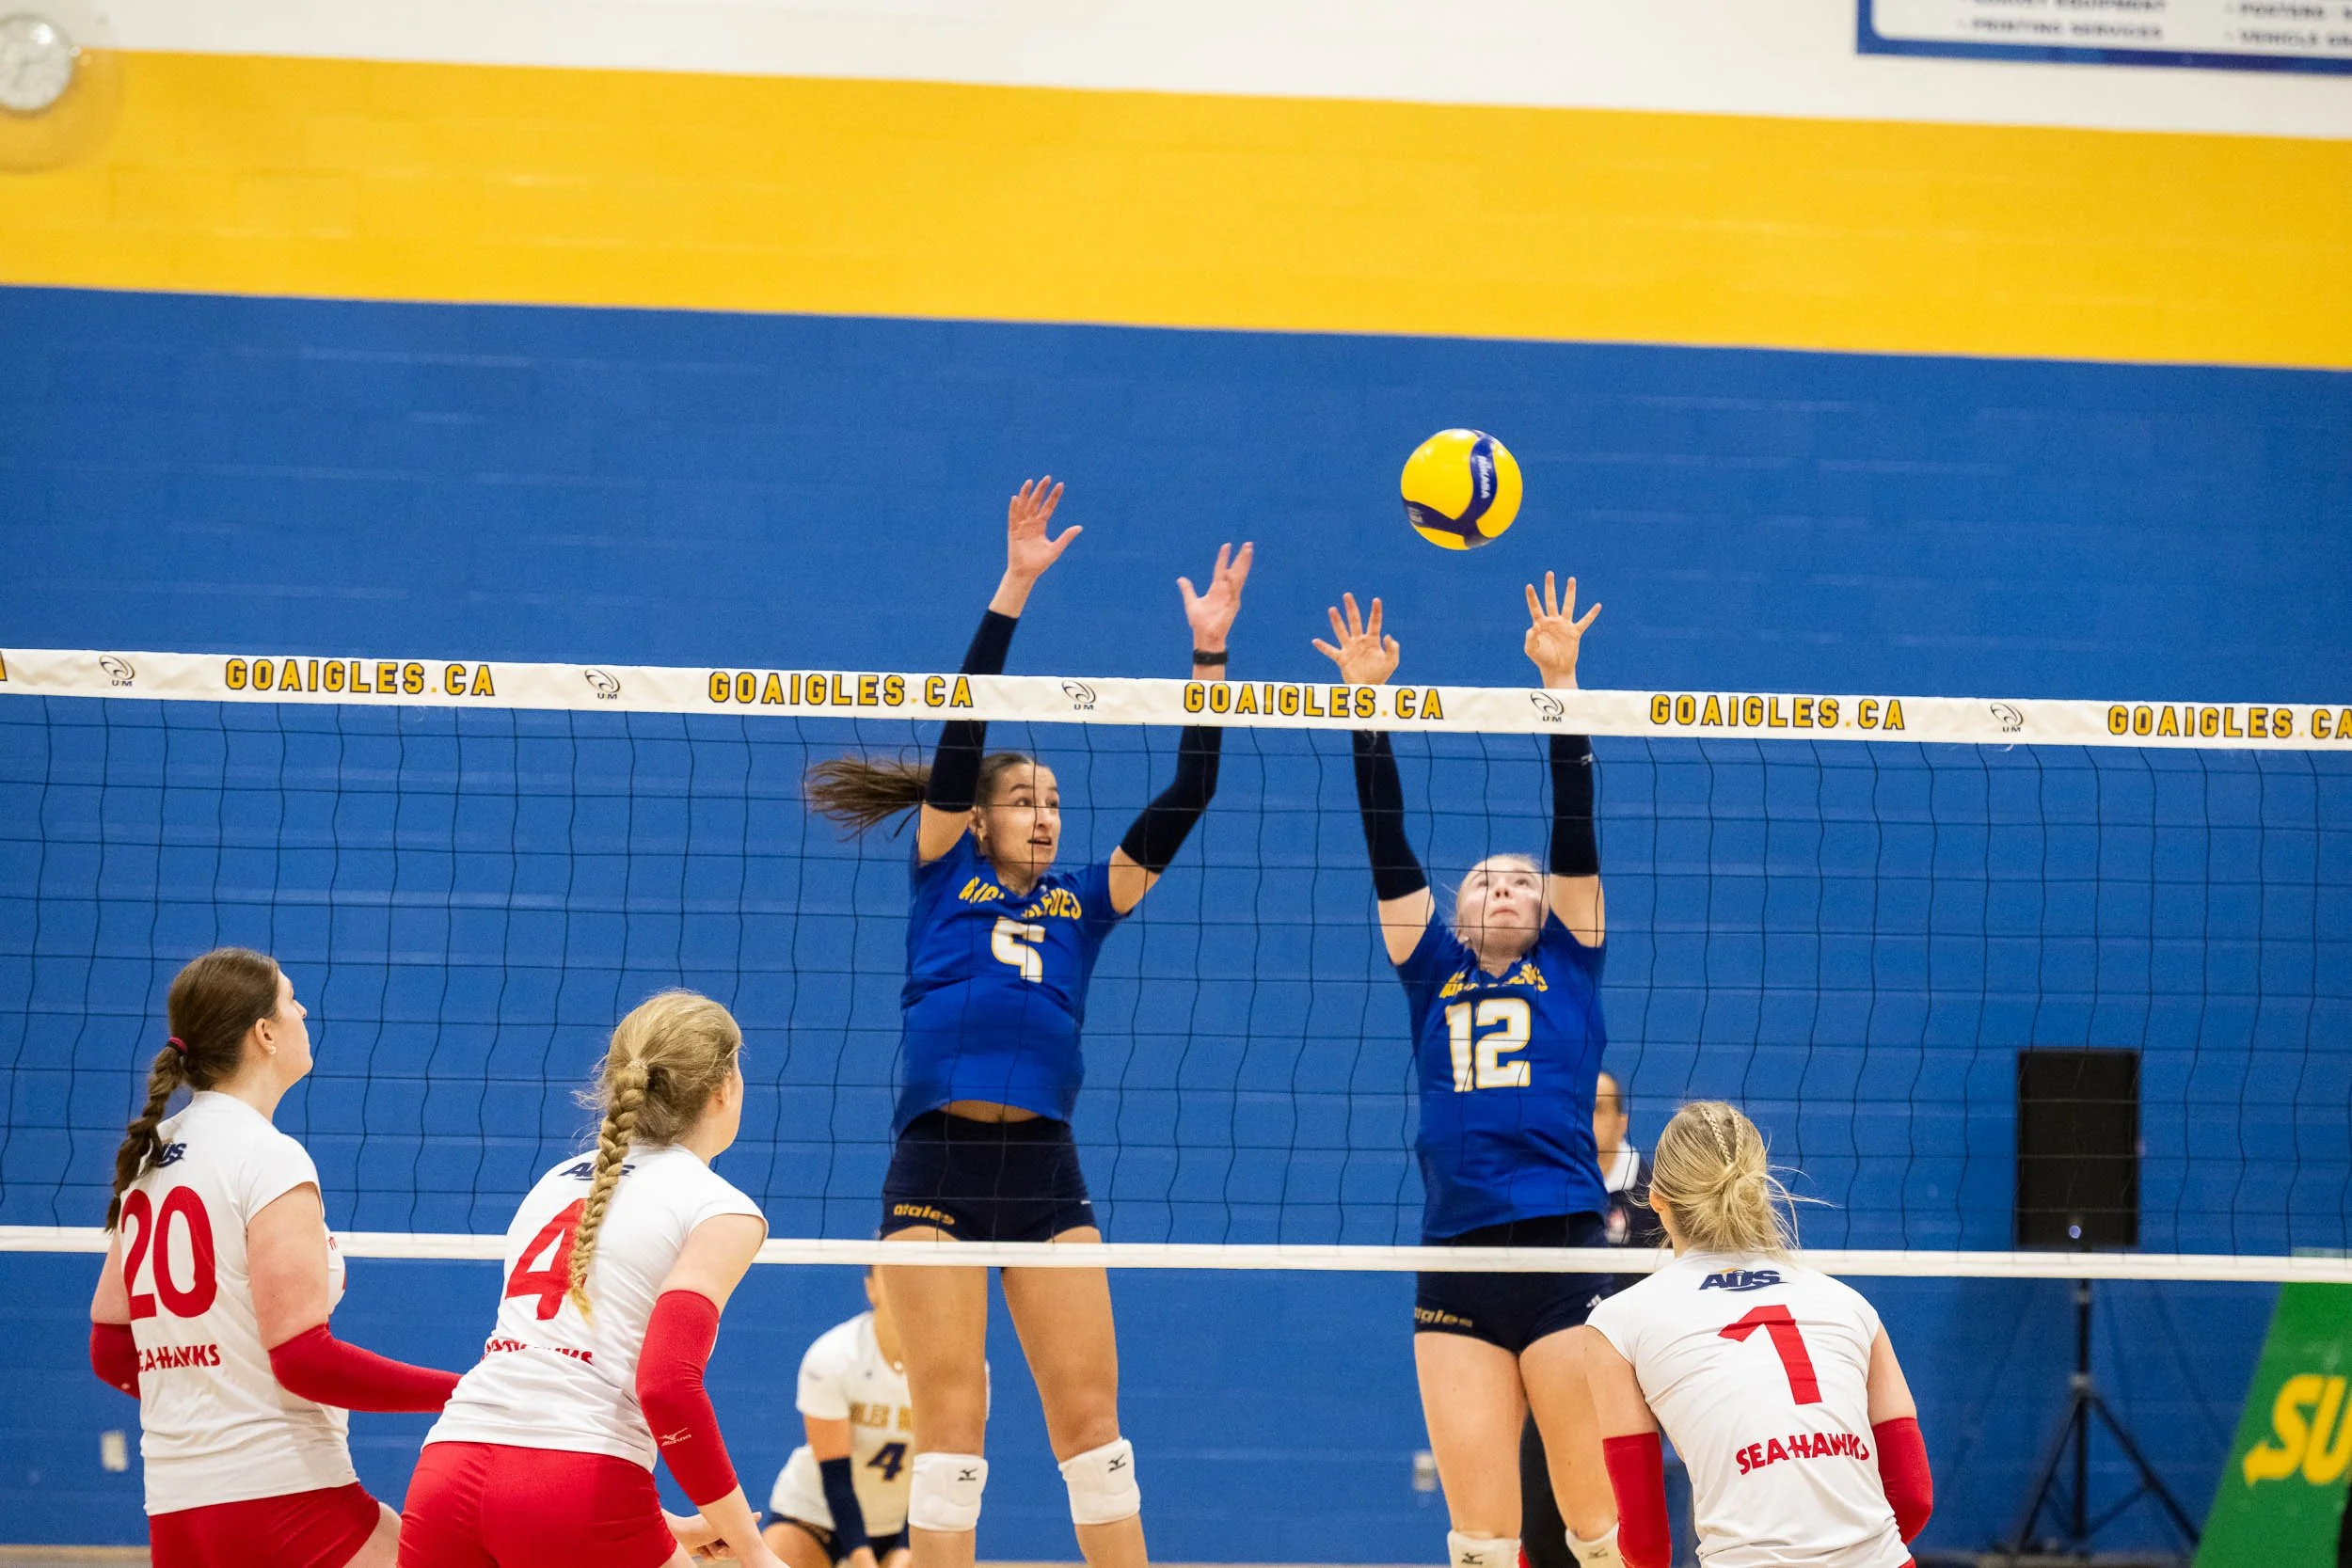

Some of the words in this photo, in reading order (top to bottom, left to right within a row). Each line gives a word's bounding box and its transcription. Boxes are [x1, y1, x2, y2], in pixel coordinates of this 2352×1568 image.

[225, 658, 495, 697] GOAIGLES.CA
[708, 672, 974, 708] GOAIGLES.CA
[1184, 681, 1444, 721] GOAIGLES.CA
[1649, 694, 1905, 730] GOAIGLES.CA
[2107, 705, 2352, 739] GOAIGLES.CA
[991, 915, 1046, 984] 5
[1445, 997, 1531, 1093] 12
[121, 1185, 217, 1321] 20
[505, 1197, 588, 1321] 4
[1717, 1304, 1822, 1405] 1
[866, 1442, 908, 1482] 4
